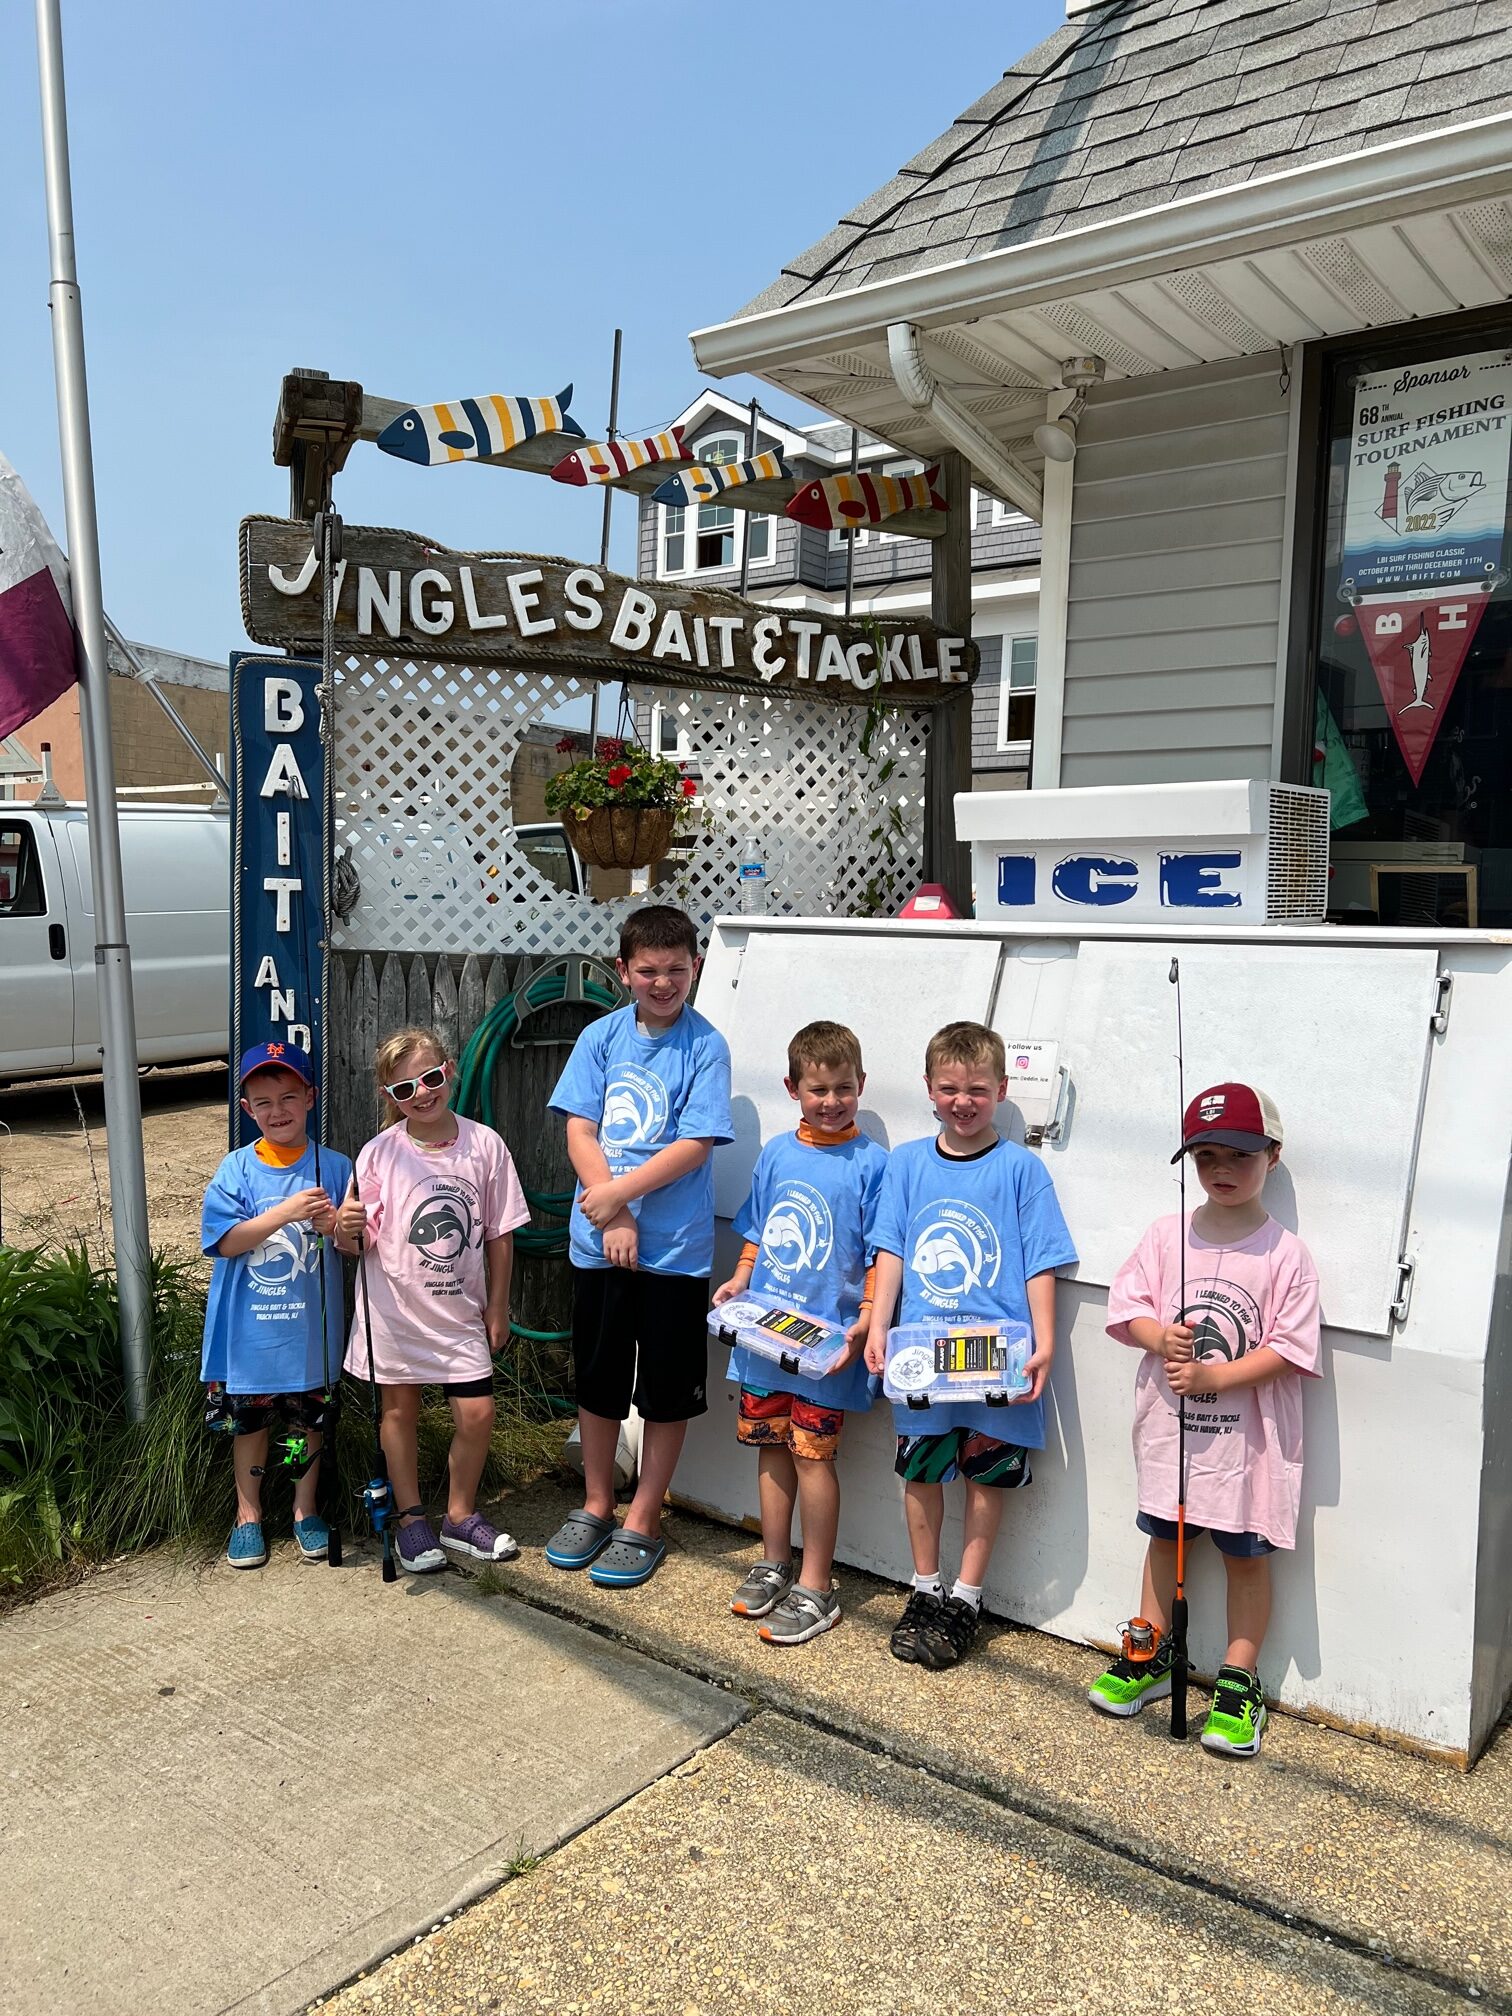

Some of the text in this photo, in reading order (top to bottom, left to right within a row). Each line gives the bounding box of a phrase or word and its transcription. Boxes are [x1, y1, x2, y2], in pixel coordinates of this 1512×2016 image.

[1392, 365, 1471, 396] Sponsor
[1357, 394, 1506, 447] SURF FISHING
[1359, 403, 1390, 426] 68 TH
[1381, 412, 1404, 423] ANNUAL
[1354, 415, 1507, 466] TOURNAMENT
[1405, 513, 1437, 533] 2022
[1358, 565, 1389, 576] OCTOBER
[1405, 561, 1423, 571] THRU
[1424, 558, 1462, 570] DECEMBER
[1464, 556, 1483, 566] 11TH
[1377, 547, 1465, 564] LBI SURF FISHING CLASSIC
[1375, 611, 1403, 635] B
[1438, 603, 1467, 631] H
[610, 587, 744, 668] BAIT
[751, 615, 786, 683] &
[787, 619, 968, 691] TACKLE
[259, 677, 310, 933] BAIT
[995, 849, 1243, 907] ICE
[253, 955, 312, 1055] AND
[419, 1259, 454, 1274] AT JINGLE
[1199, 1290, 1231, 1304] LEARNED
[1229, 1300, 1242, 1311] TO
[1237, 1308, 1253, 1325] FISH
